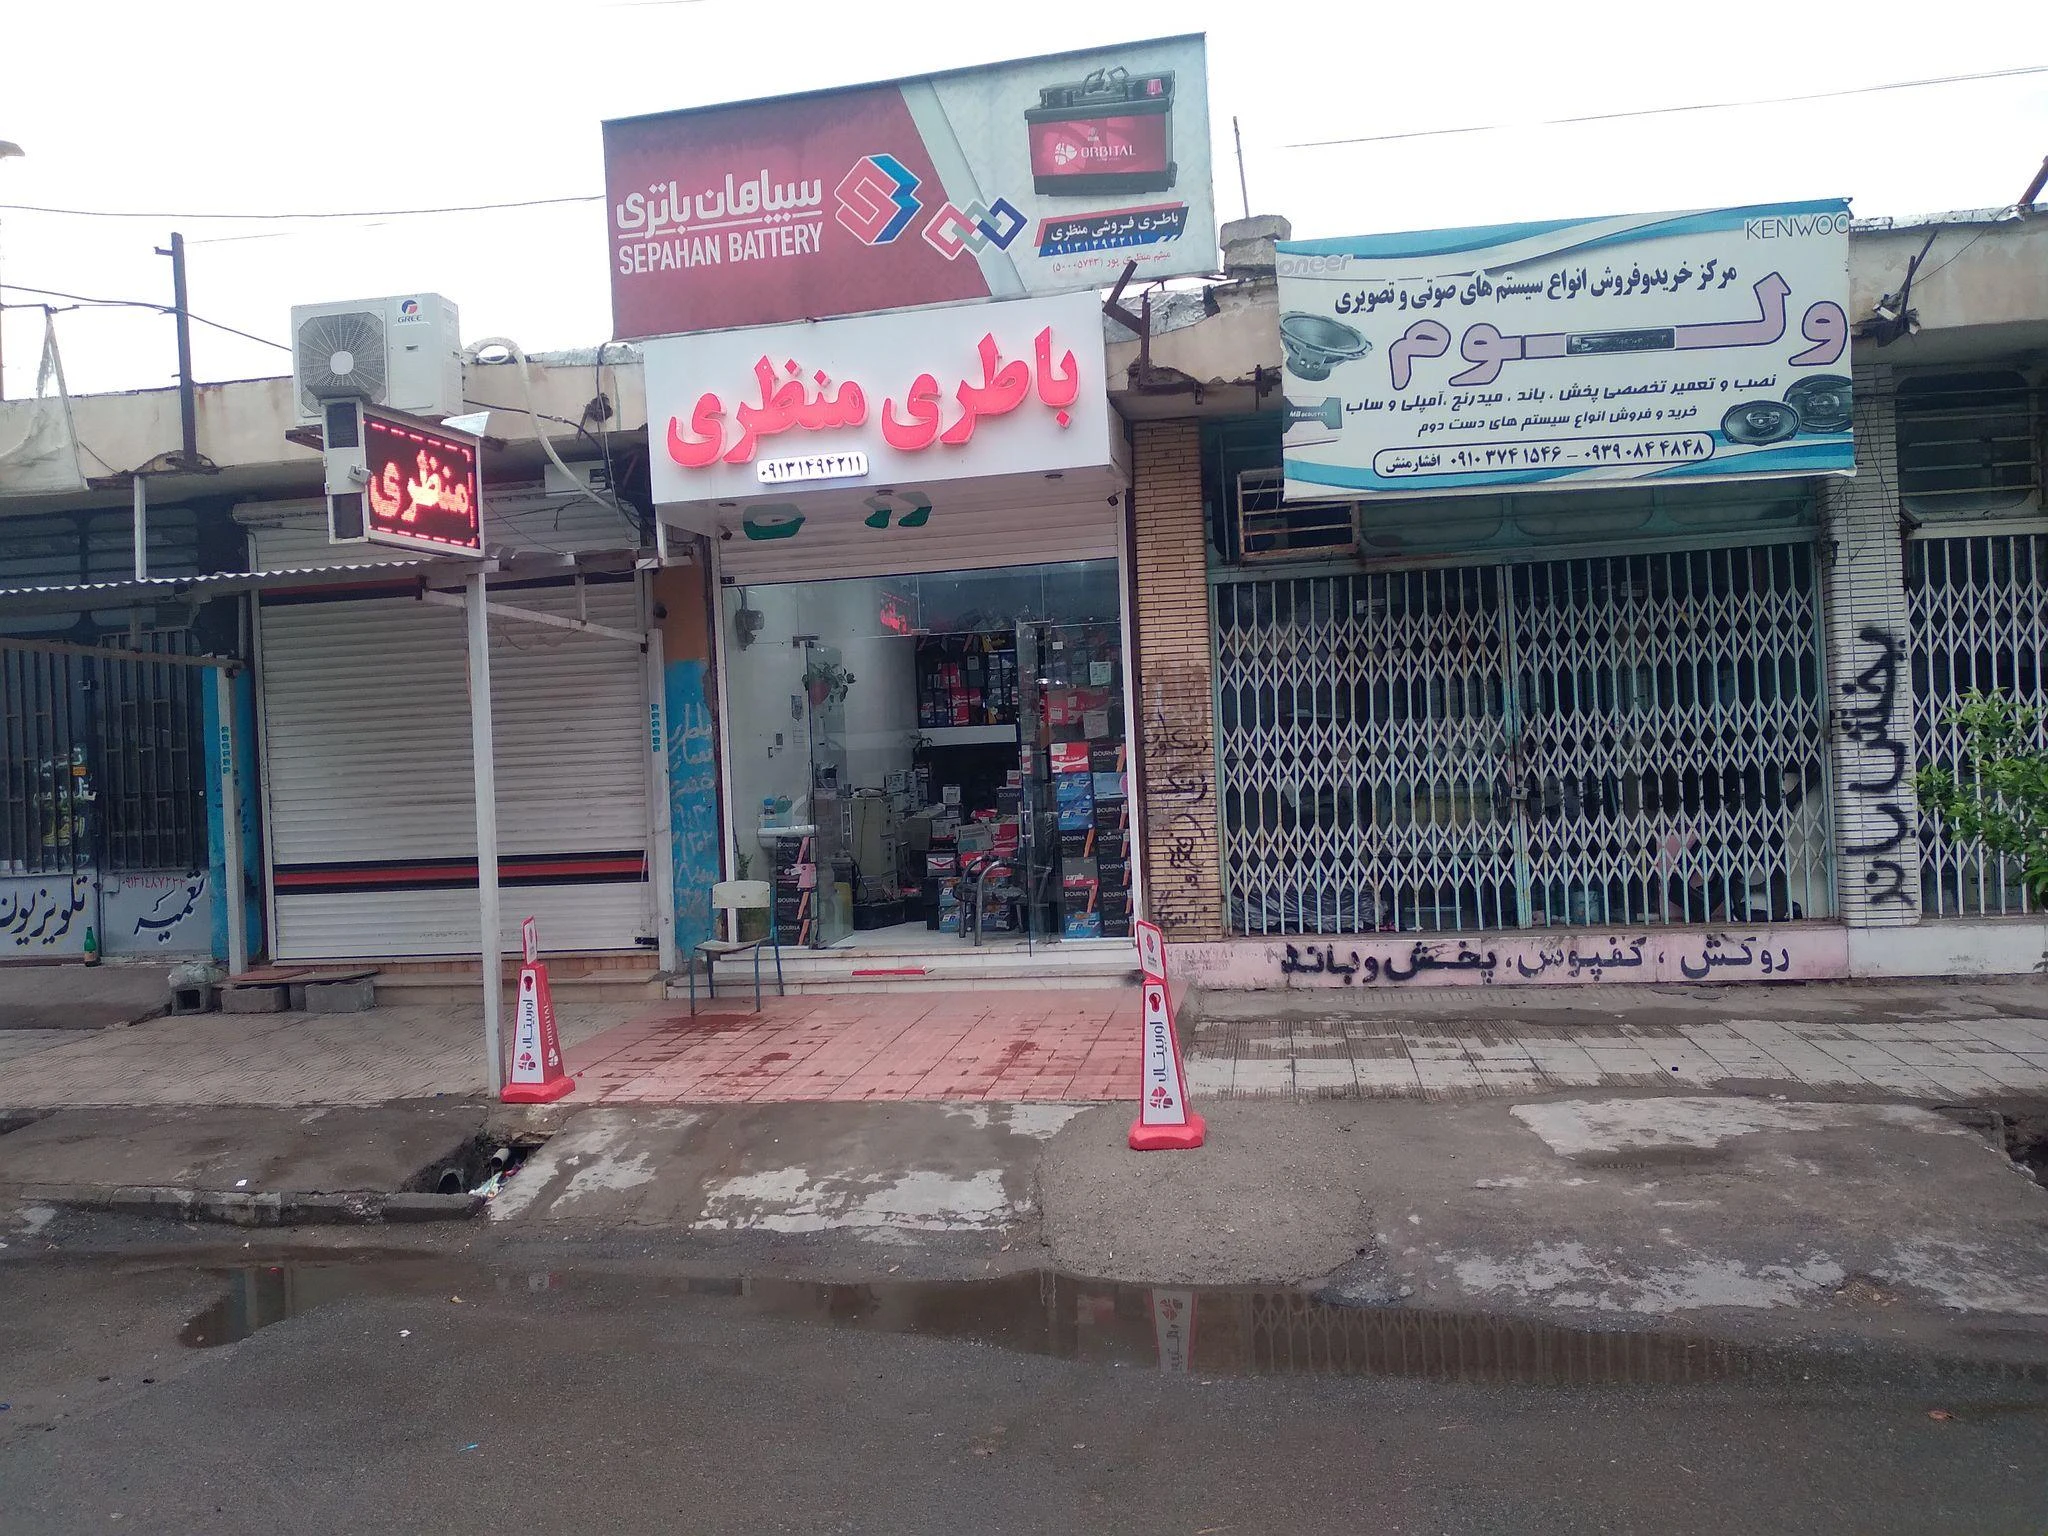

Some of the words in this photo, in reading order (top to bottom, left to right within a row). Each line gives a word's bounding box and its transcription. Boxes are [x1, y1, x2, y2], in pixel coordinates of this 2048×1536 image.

[1081, 144, 1136, 159] ORBITAL
[696, 169, 823, 223] سپاهان
[616, 181, 691, 239] باتری
[1051, 223, 1089, 242] منظری
[1092, 216, 1135, 238] فروشی
[1138, 212, 1179, 232] باطری
[619, 233, 721, 275] SEPAHAN
[729, 222, 824, 263] BATTERY
[1547, 268, 1587, 300] انواع
[1697, 258, 1738, 291] مرکز
[1335, 282, 1395, 315] تصویری
[1411, 278, 1456, 309] صوتی
[1460, 271, 1493, 306] های
[1496, 273, 1543, 303] سیستم
[1398, 290, 1407, 311] و
[397, 314, 423, 324] GREE
[881, 325, 1080, 451] باطری
[1603, 381, 1667, 401] تخصصی
[1670, 377, 1717, 395] تعمیر
[1720, 380, 1728, 392] و
[1734, 374, 1777, 390] نصب
[1517, 388, 1545, 402] باند
[1559, 384, 1598, 403] پخش
[666, 354, 869, 468] منظری
[1345, 398, 1383, 412] ساب
[1388, 400, 1395, 412] و
[1656, 409, 1663, 420] و
[1676, 405, 1698, 418] خرید
[1449, 418, 1485, 430] دست
[1489, 416, 1518, 431] های
[1521, 412, 1570, 431] سیستم
[1574, 409, 1605, 429] انواع
[1609, 408, 1651, 424] فروش
[1418, 422, 1444, 437] دوم
[760, 455, 864, 481] ۰۹۱۳۱۴۹۴۲۱۱
[369, 449, 470, 522] منظری
[0, 876, 88, 945] تلویزیون
[134, 870, 206, 942] تعمیر
[1384, 940, 1497, 985] پخش
[1680, 933, 1790, 979] روکش
[521, 999, 536, 1049] اوربیتال
[1150, 1021, 1168, 1083] اوربیتال
